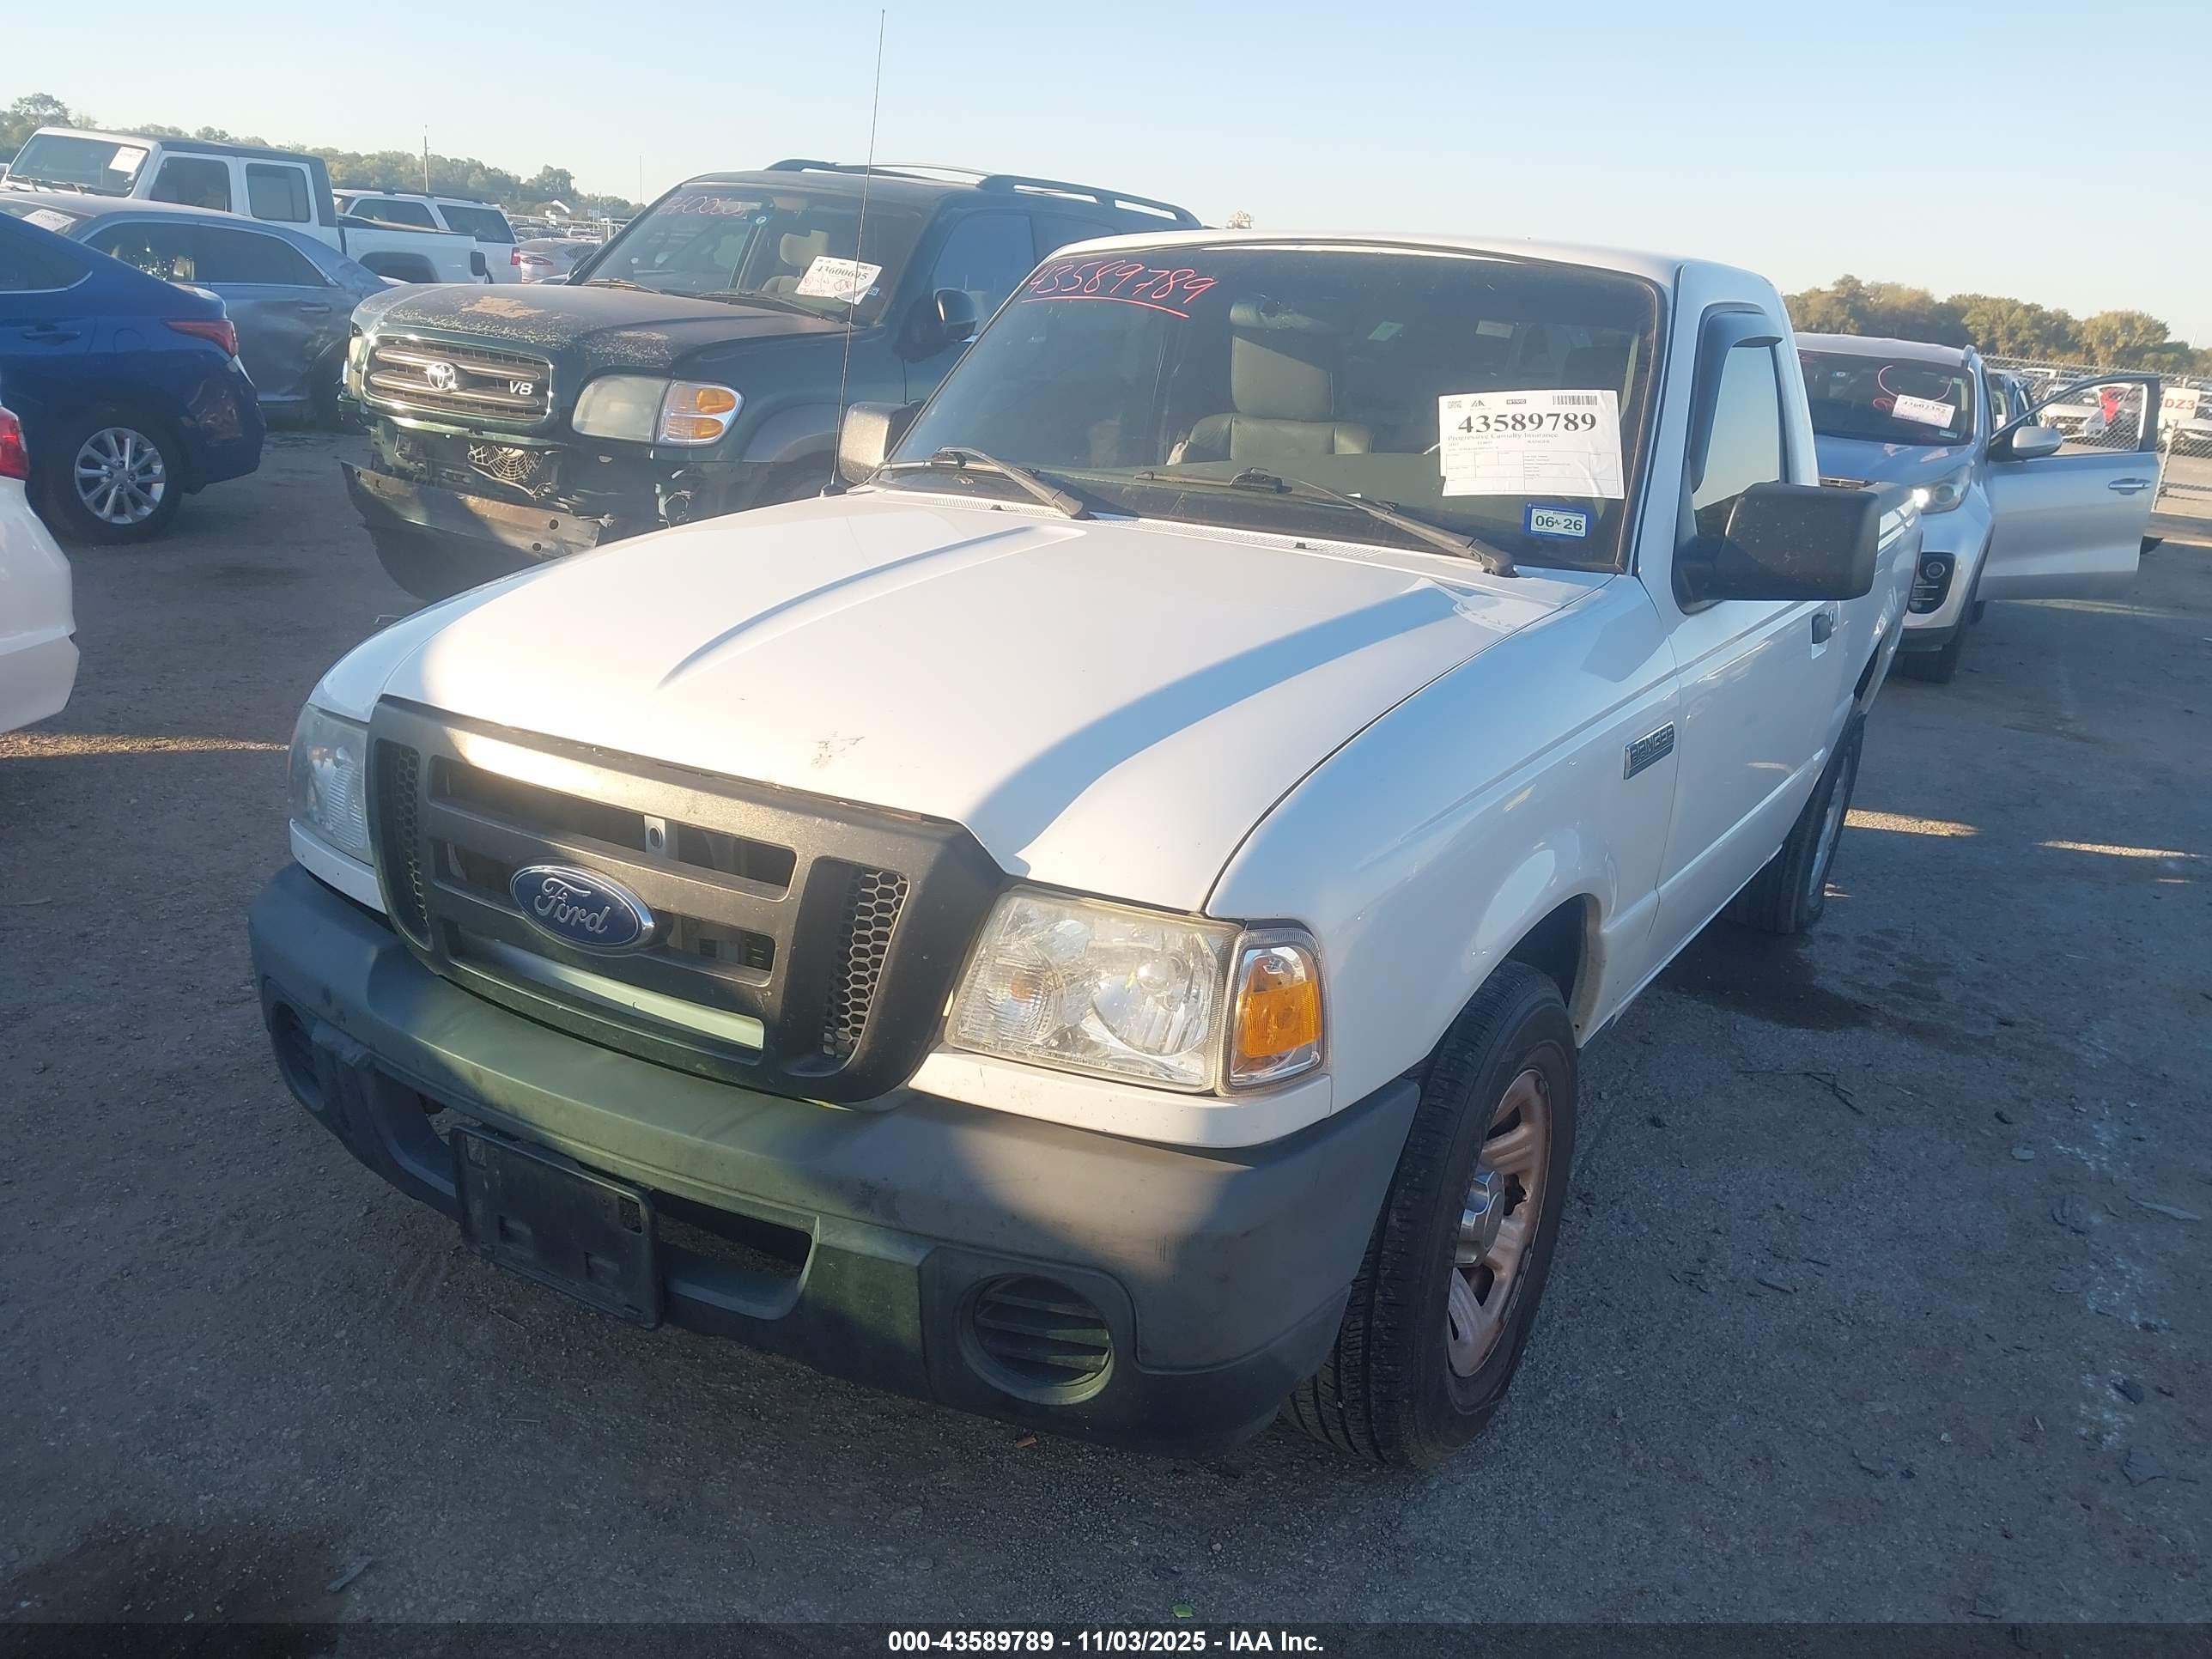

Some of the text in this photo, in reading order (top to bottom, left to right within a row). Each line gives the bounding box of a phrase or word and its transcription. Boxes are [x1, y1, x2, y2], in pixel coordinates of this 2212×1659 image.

[1030, 259, 1219, 304] 43589789
[509, 380, 533, 395] V8
[2164, 398, 2195, 410] DZ3
[1458, 413, 1596, 433] 43589789
[1535, 515, 1583, 531] 06 26
[534, 877, 611, 934] Ford
